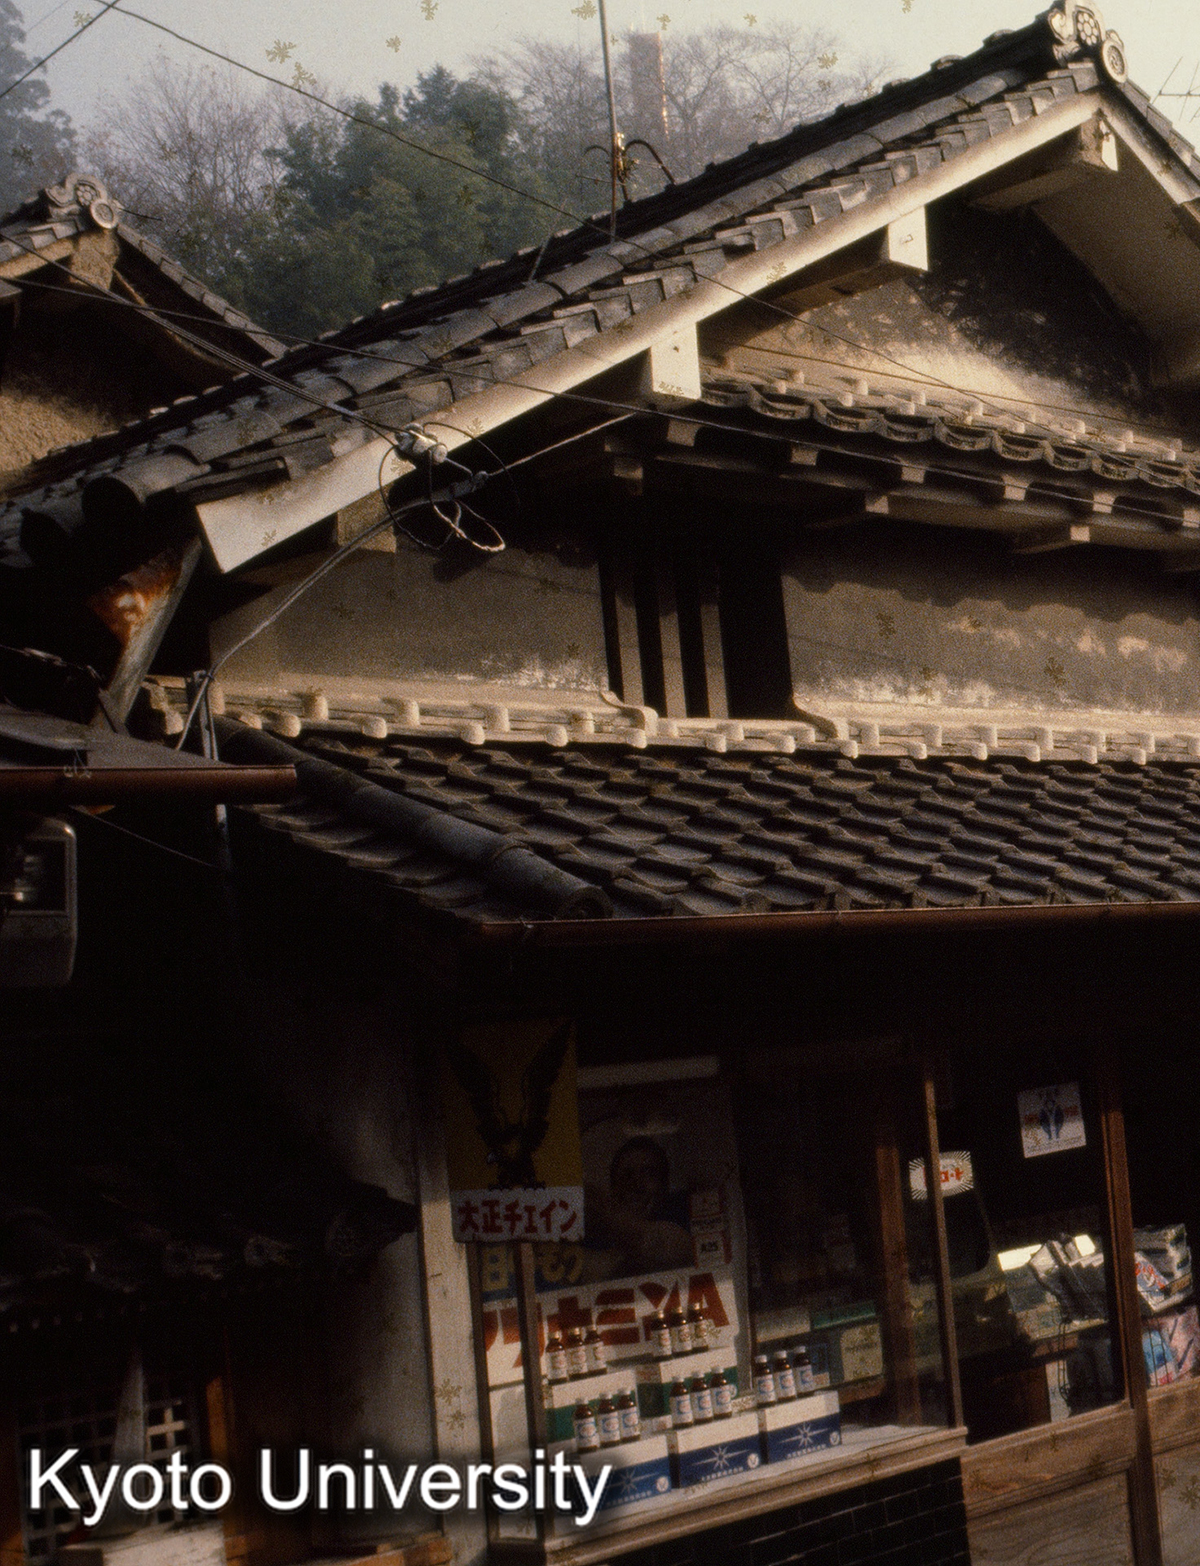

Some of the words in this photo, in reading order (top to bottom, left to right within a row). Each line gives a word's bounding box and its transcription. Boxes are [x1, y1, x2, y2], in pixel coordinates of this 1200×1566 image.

[457, 1199, 578, 1236] 大正チェイン
